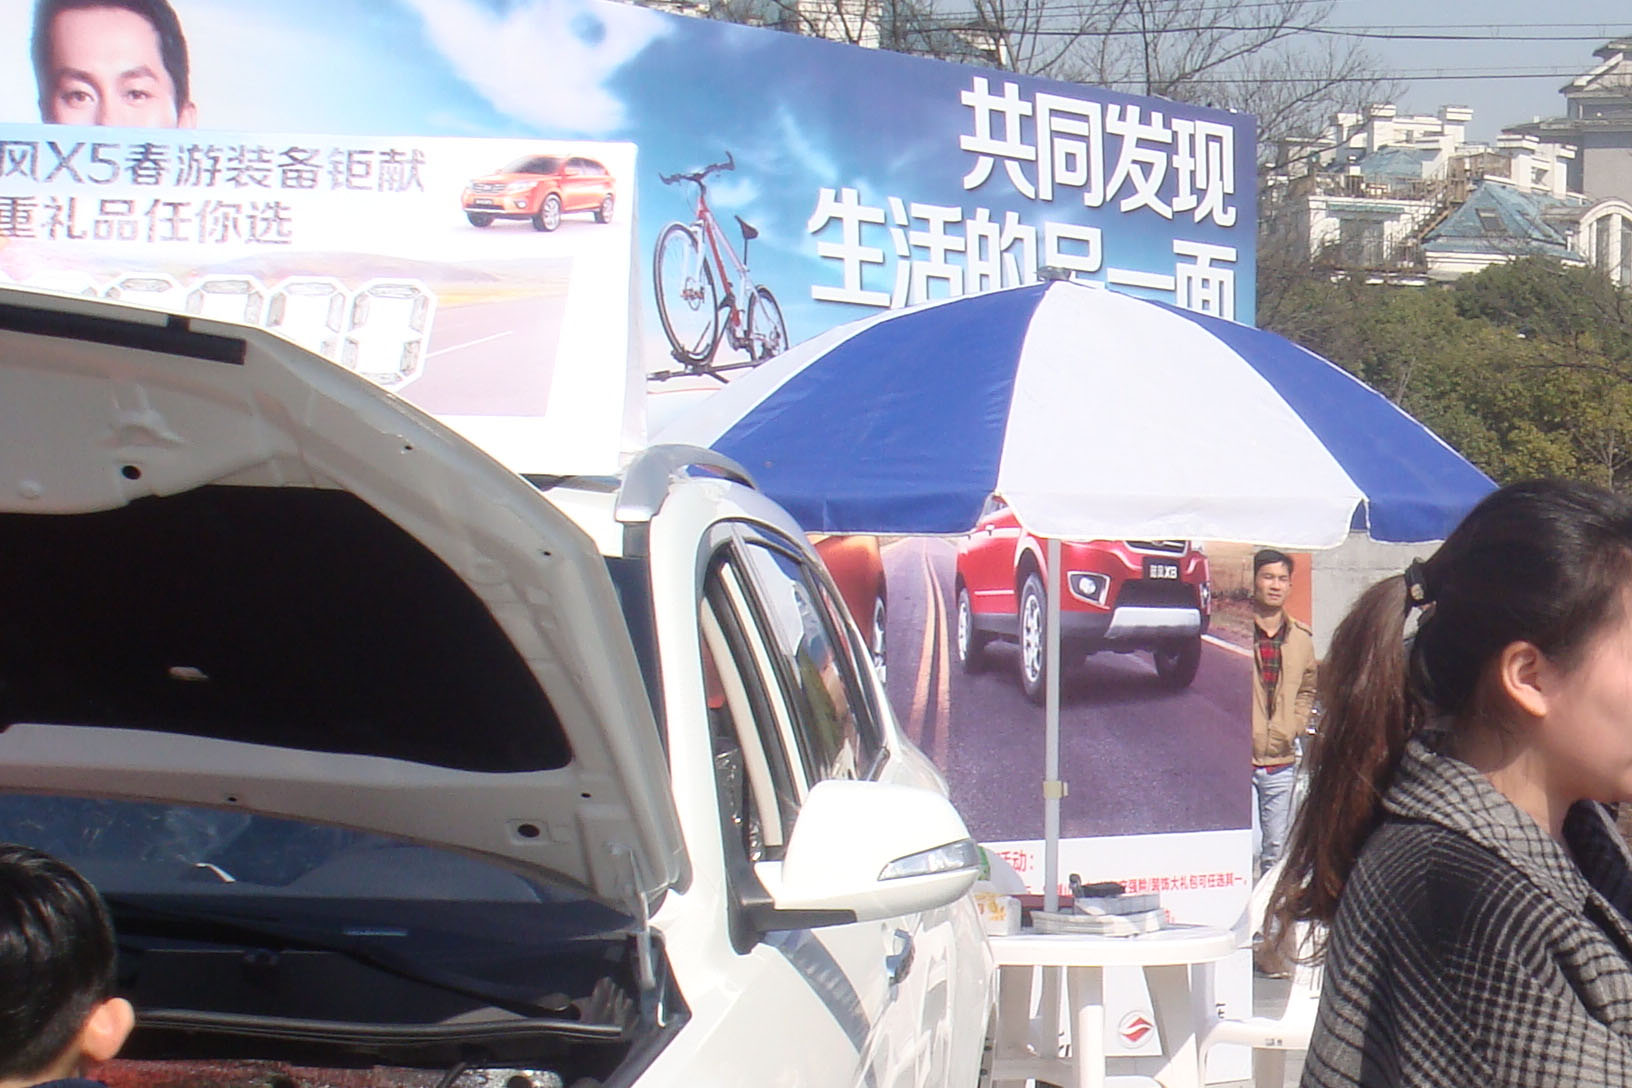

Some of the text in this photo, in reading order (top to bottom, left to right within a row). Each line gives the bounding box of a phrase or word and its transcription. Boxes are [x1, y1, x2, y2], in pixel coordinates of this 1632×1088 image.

[960, 76, 1237, 227] 共同发现
[0, 196, 293, 245] 重礼品任你选
